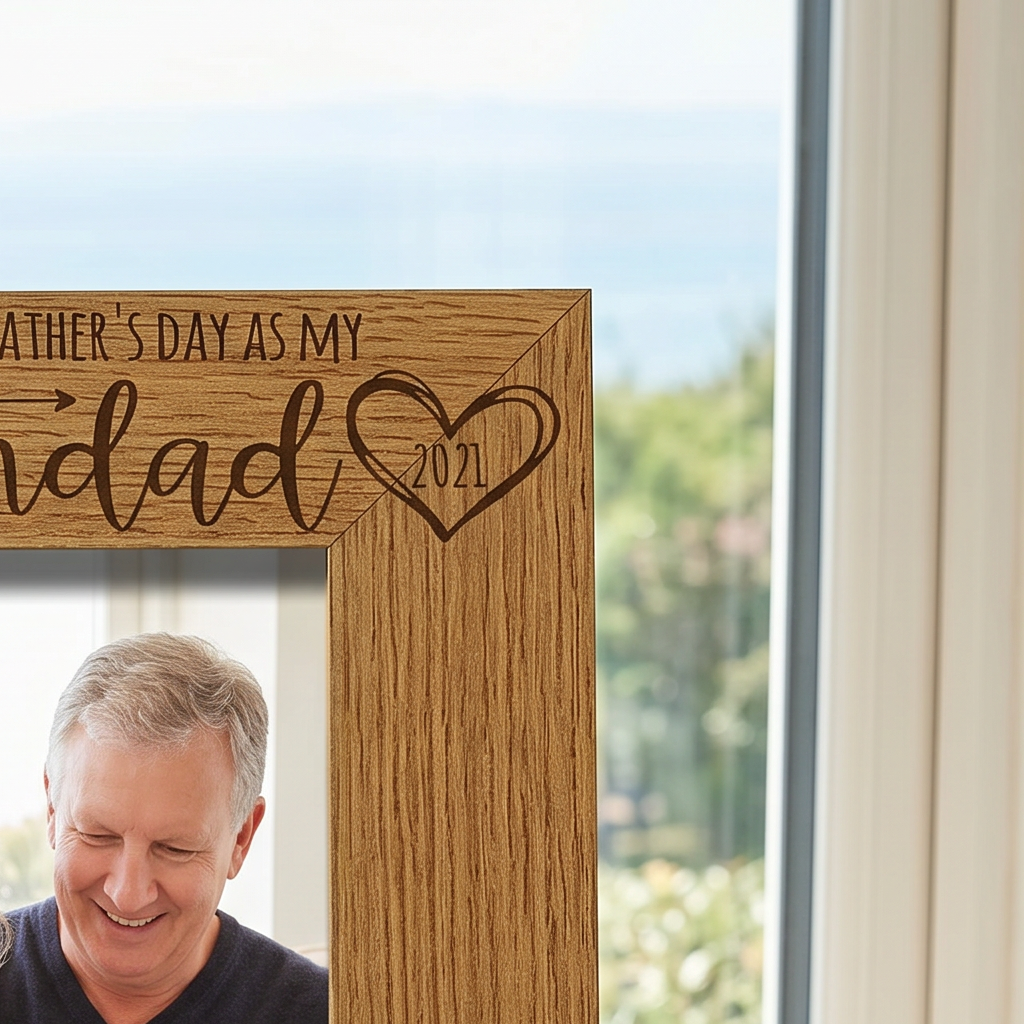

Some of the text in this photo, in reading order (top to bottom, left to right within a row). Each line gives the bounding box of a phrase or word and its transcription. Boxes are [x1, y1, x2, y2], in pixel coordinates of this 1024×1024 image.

[157, 311, 230, 362] DAY
[242, 311, 286, 362] AS
[299, 312, 362, 363] MY
[412, 443, 486, 488] 2021
